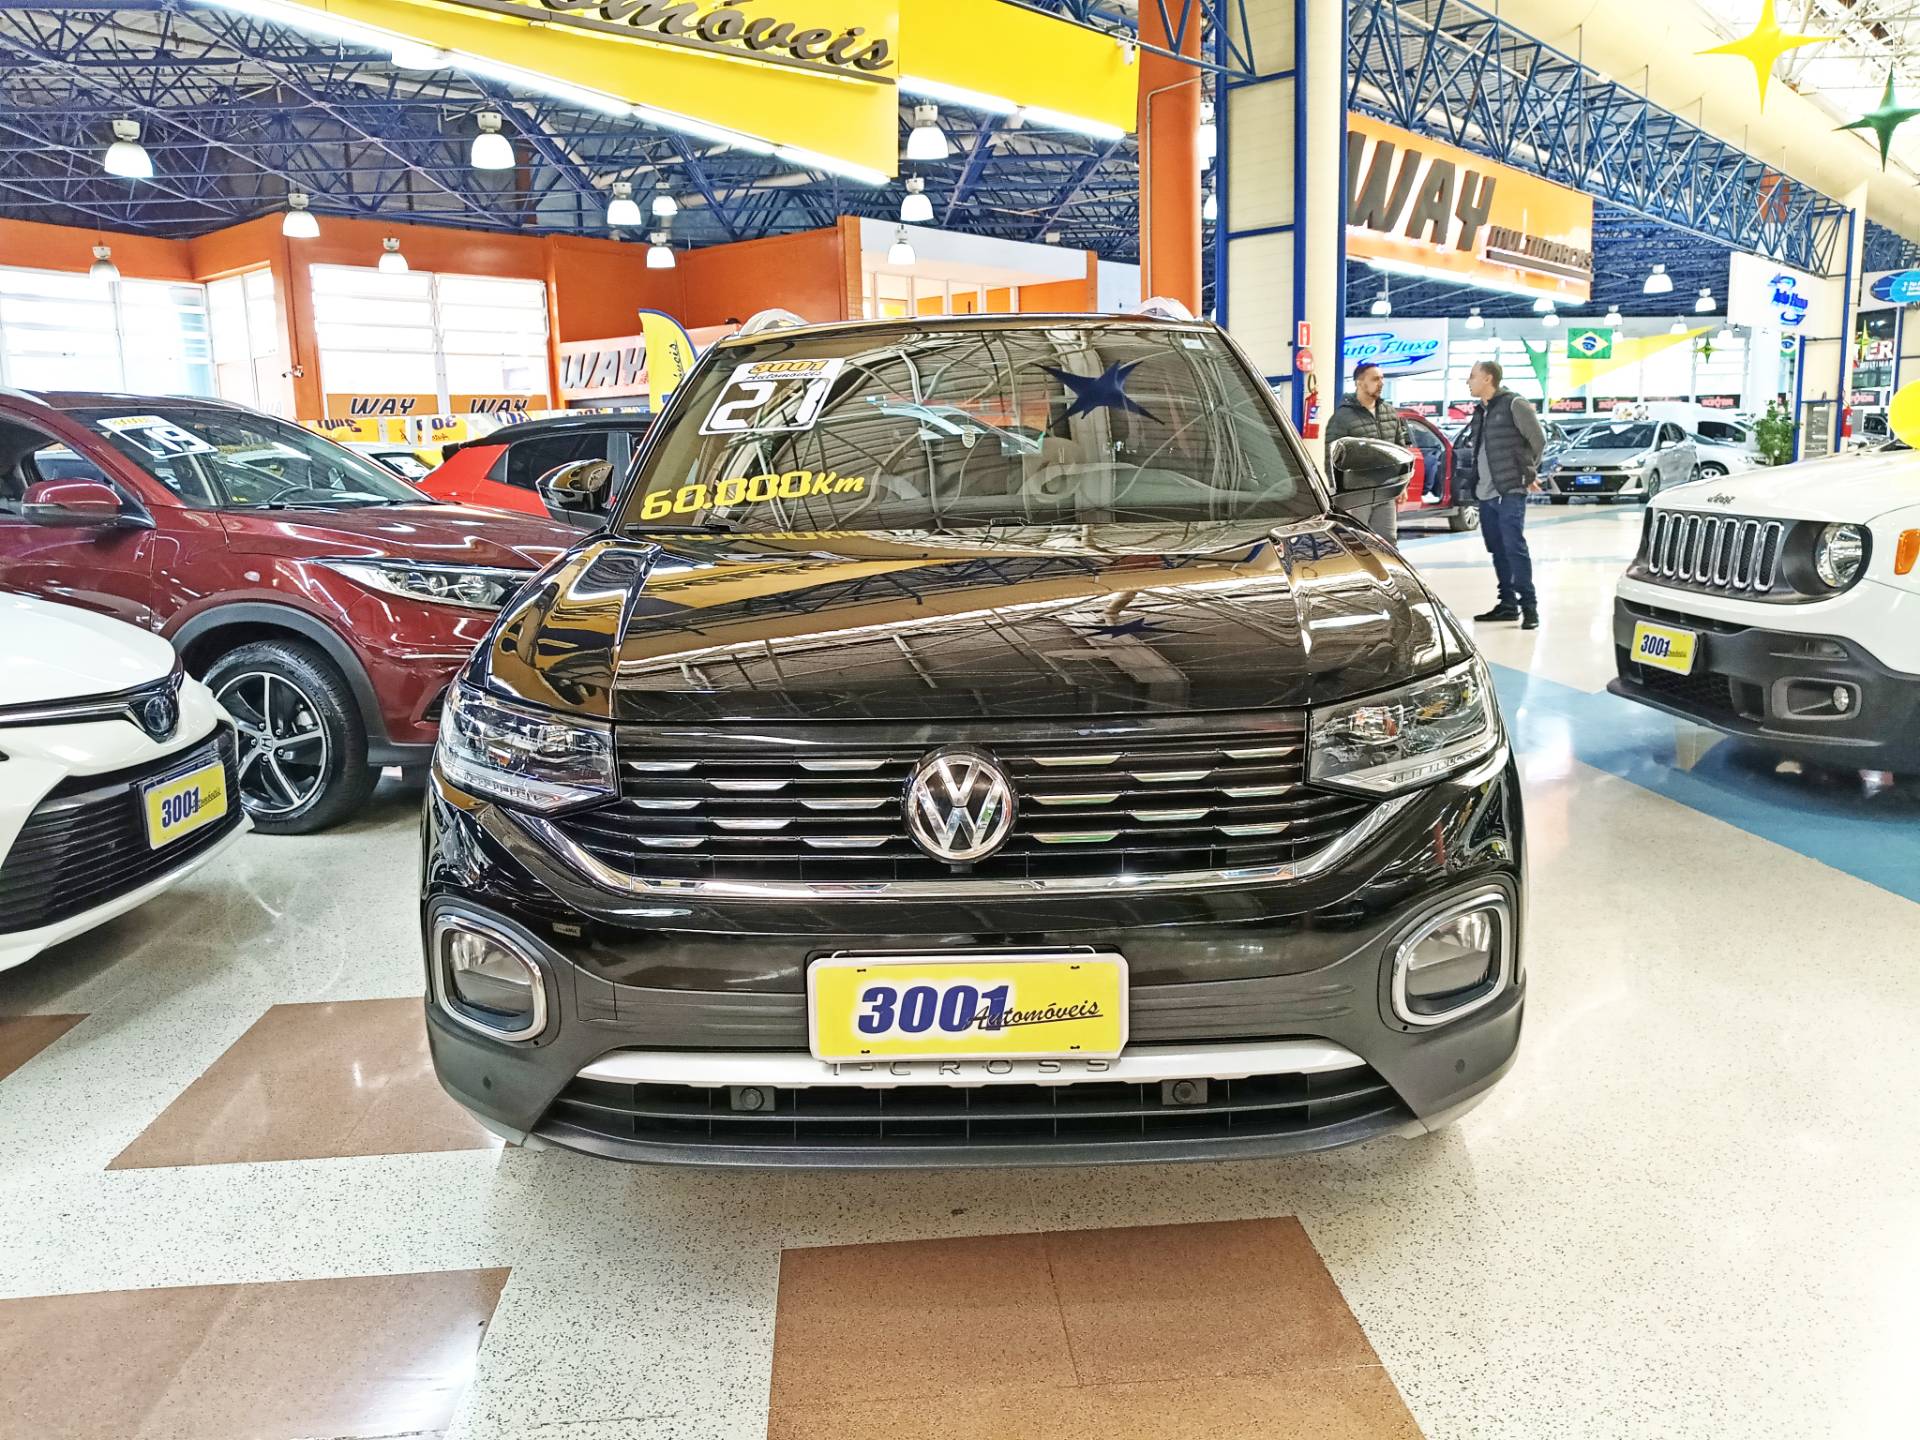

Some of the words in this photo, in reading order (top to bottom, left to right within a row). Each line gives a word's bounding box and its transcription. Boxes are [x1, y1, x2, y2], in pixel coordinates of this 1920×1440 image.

[538, 0, 895, 71] móveis
[1348, 131, 1496, 252] WAY
[562, 346, 647, 388] WAY
[1382, 339, 1438, 353] Fluxo
[748, 360, 830, 375] 3001
[351, 398, 416, 415] WAY
[470, 399, 528, 414] WAY
[709, 379, 828, 430] 21
[1640, 634, 1671, 657] 3001
[161, 786, 200, 828] 3001
[857, 985, 1009, 1034] 3001
[963, 999, 1104, 1031] Automóveis
